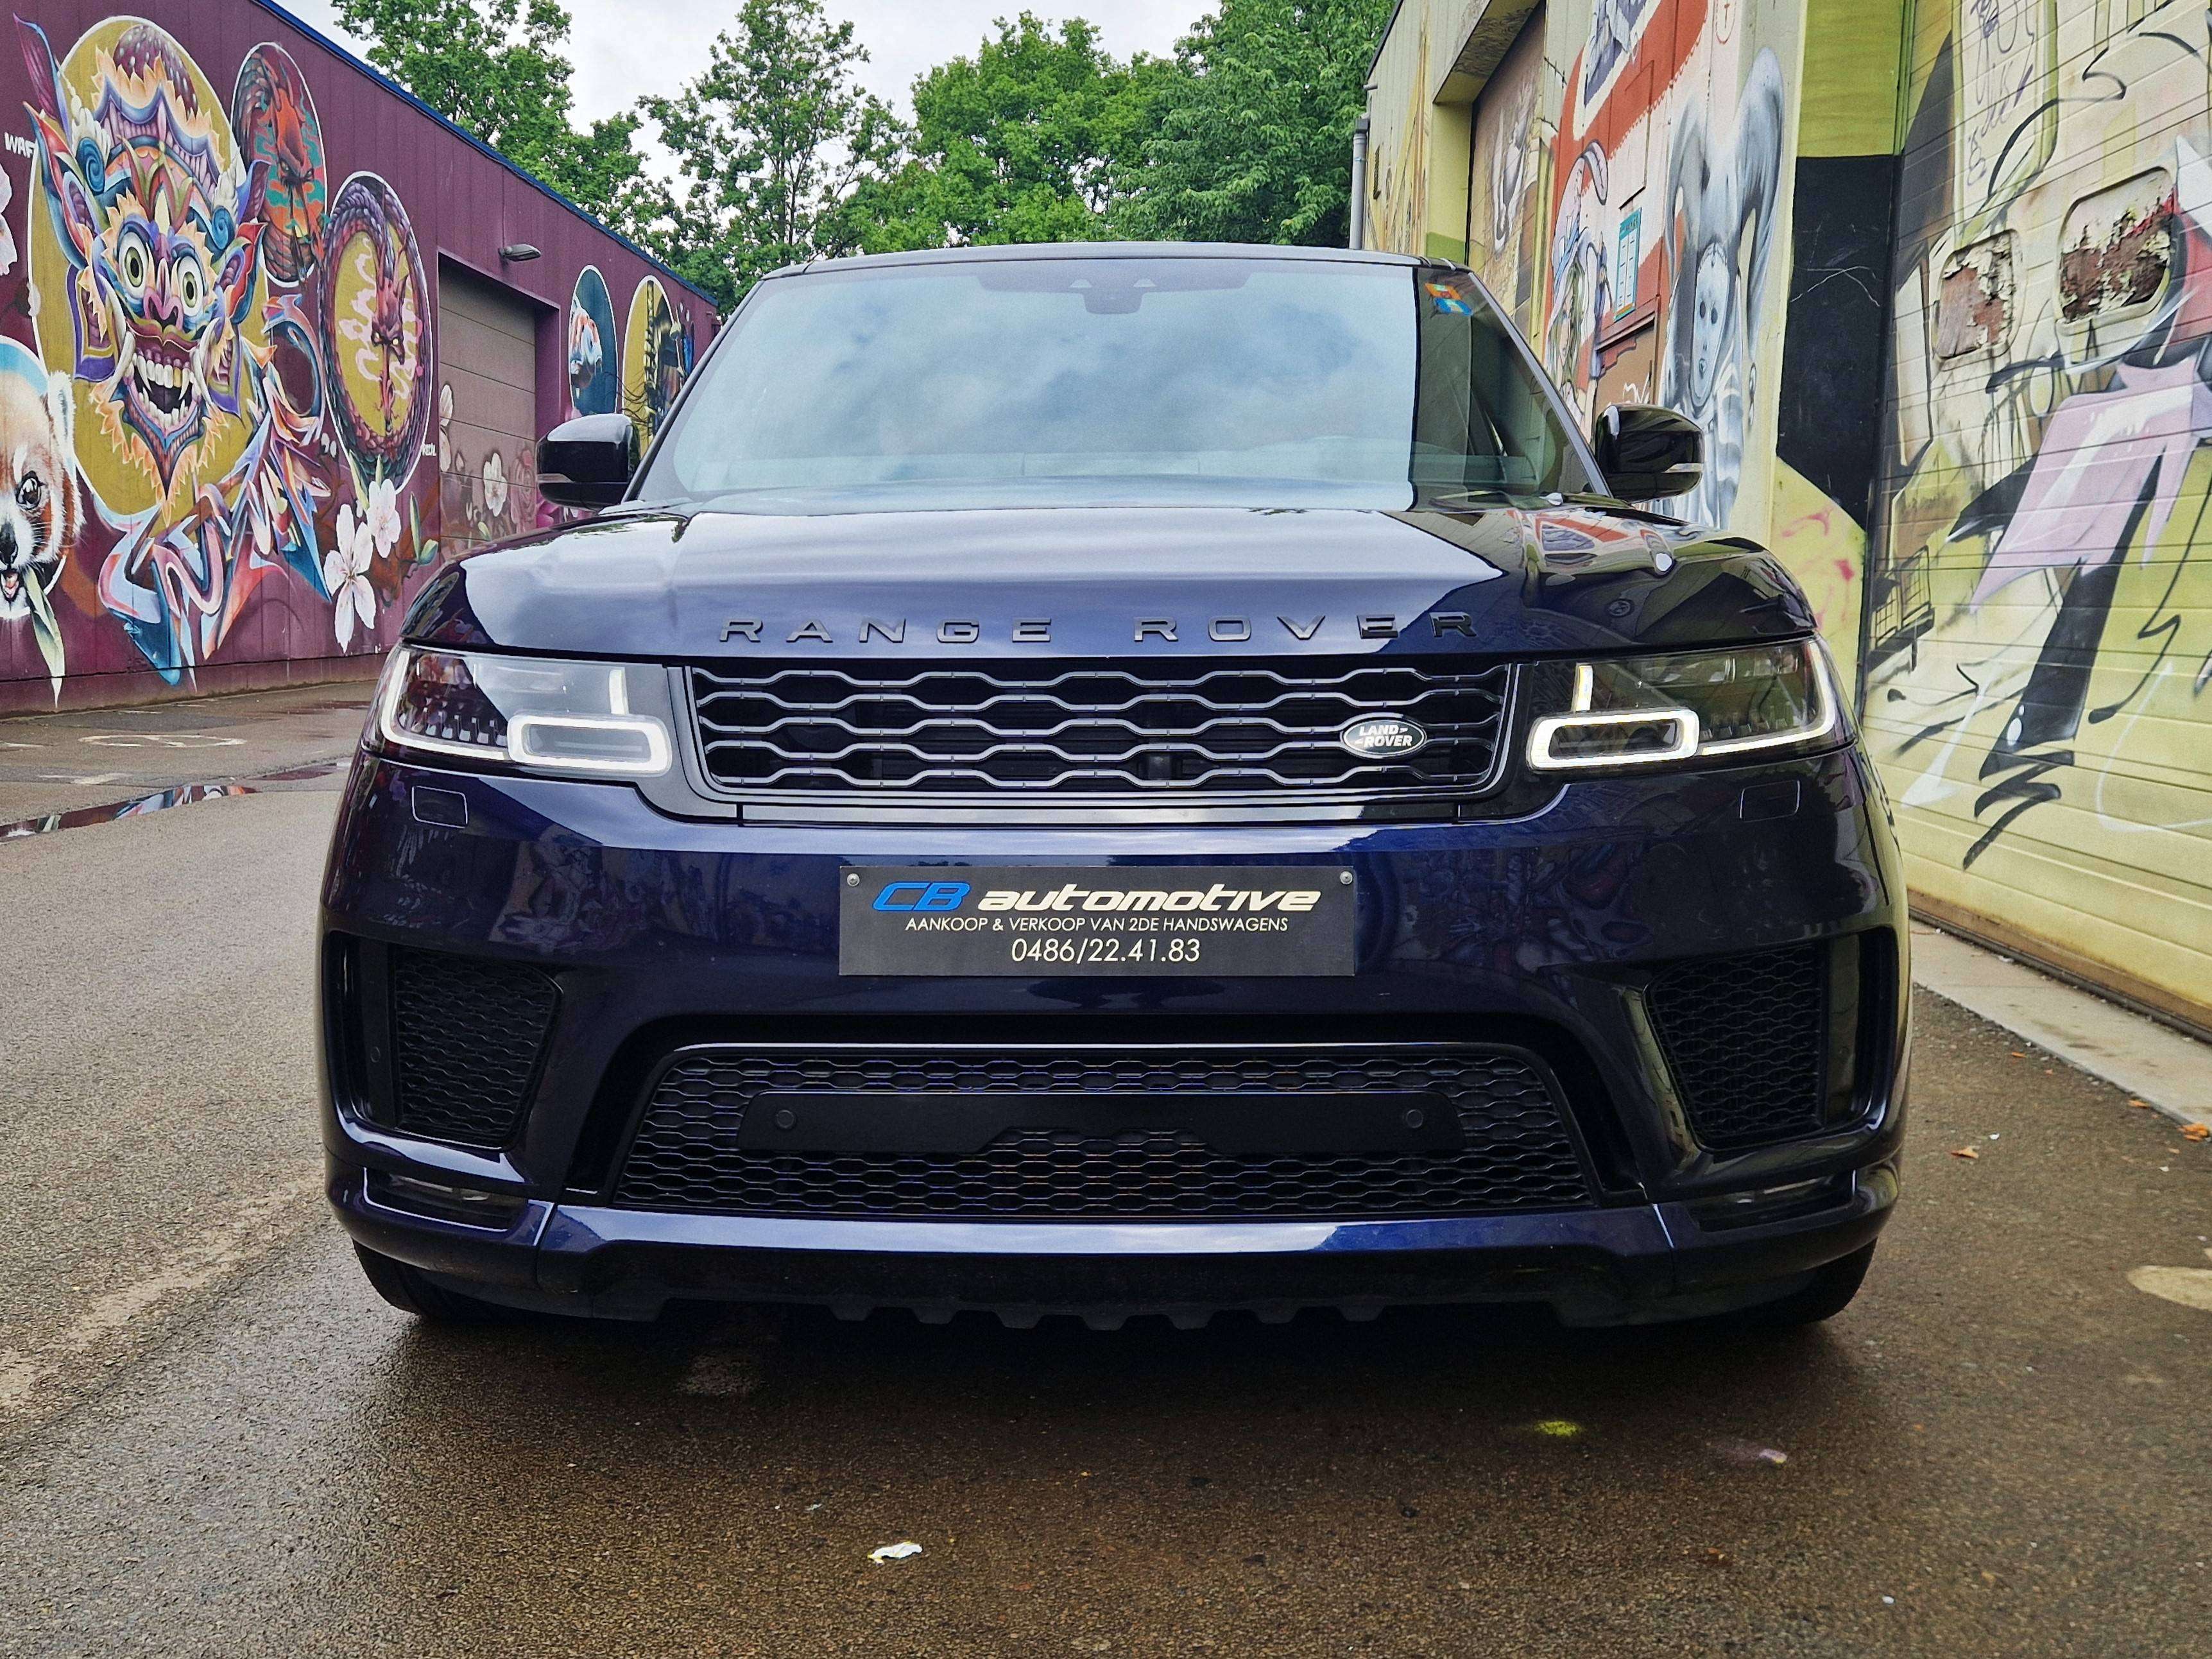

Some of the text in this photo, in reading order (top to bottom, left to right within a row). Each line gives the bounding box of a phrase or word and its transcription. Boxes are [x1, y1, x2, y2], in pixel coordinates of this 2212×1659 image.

[719, 612, 1477, 643] RANGE ROVER
[1359, 725, 1399, 736] LAND
[1364, 735, 1412, 747] ROVER
[872, 881, 1321, 912] CB automotive
[905, 917, 1289, 931] AANKOOP & VERKOOP VAN 2DE HANDSWAGENS
[1011, 938, 1201, 964] 0486/22.41.83
